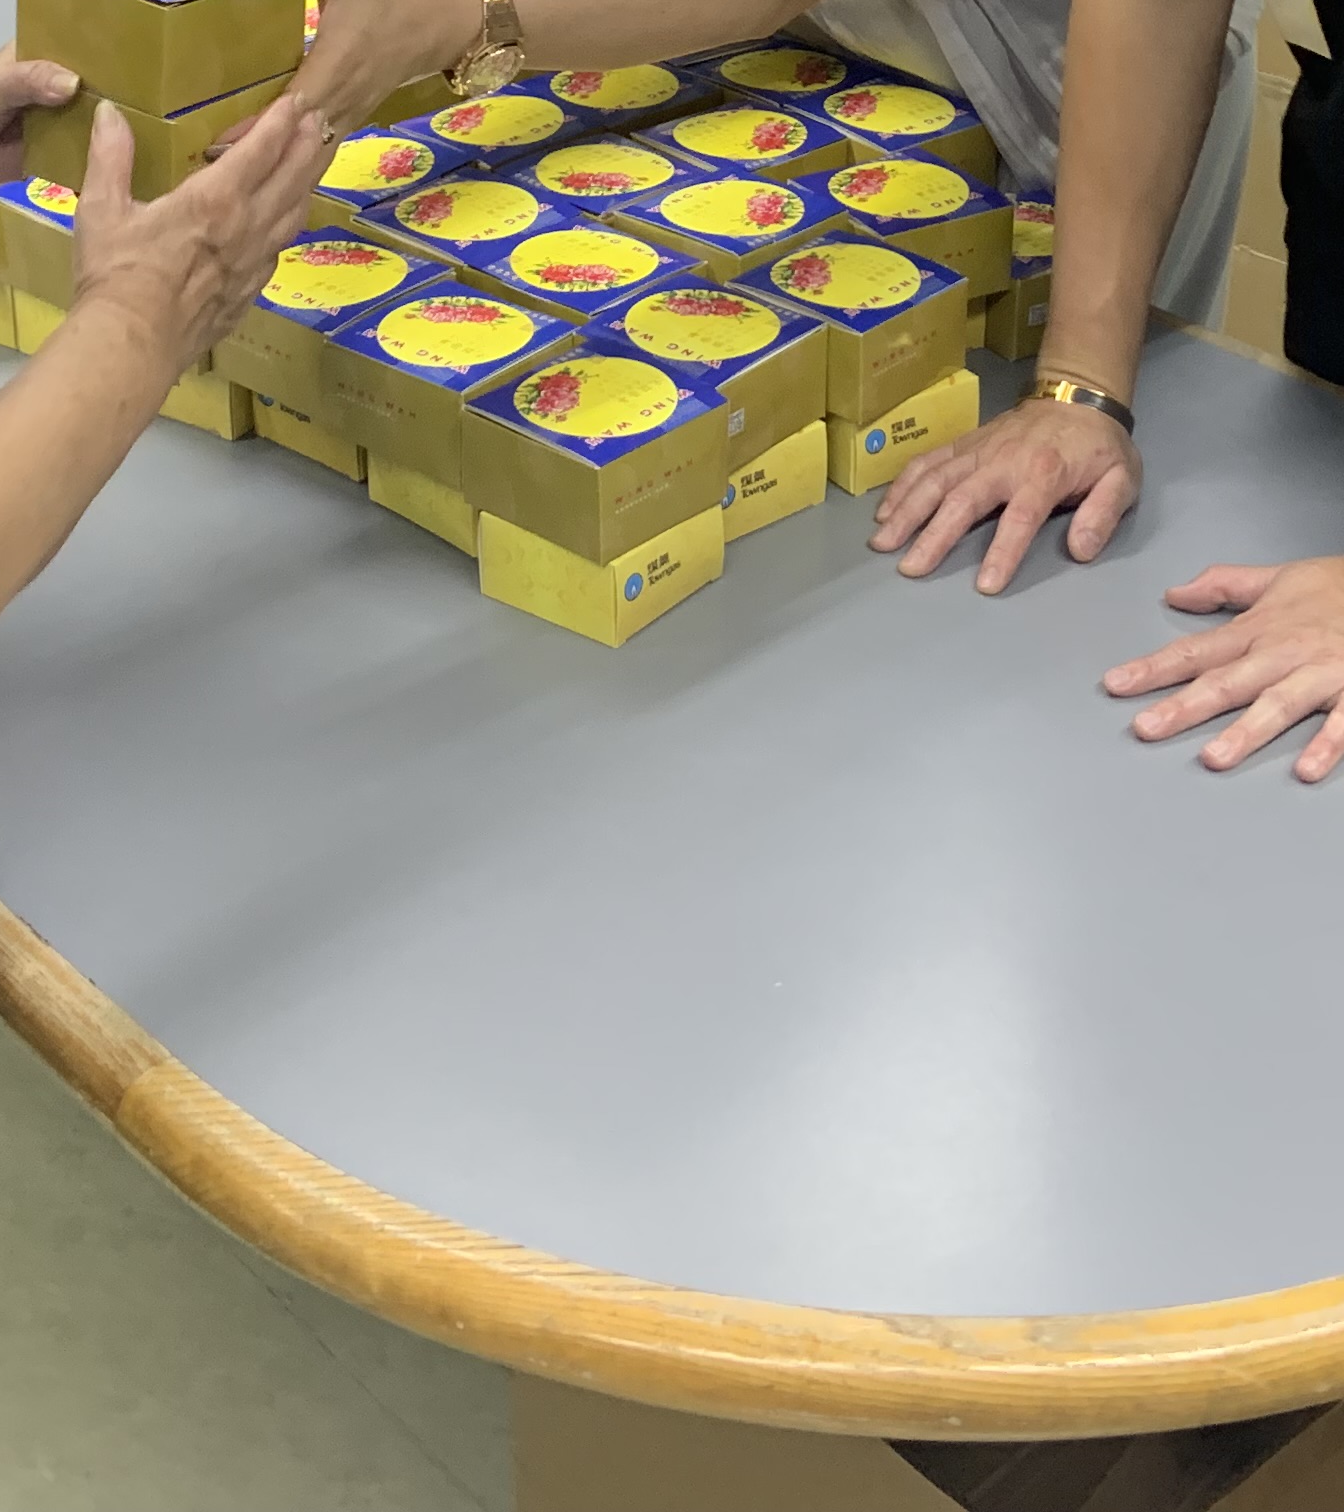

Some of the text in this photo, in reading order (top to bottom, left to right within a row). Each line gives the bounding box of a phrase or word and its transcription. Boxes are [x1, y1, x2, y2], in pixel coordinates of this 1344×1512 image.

[892, 426, 929, 445] Towngas
[741, 478, 778, 499] Towngas
[647, 560, 682, 586] Towngas
